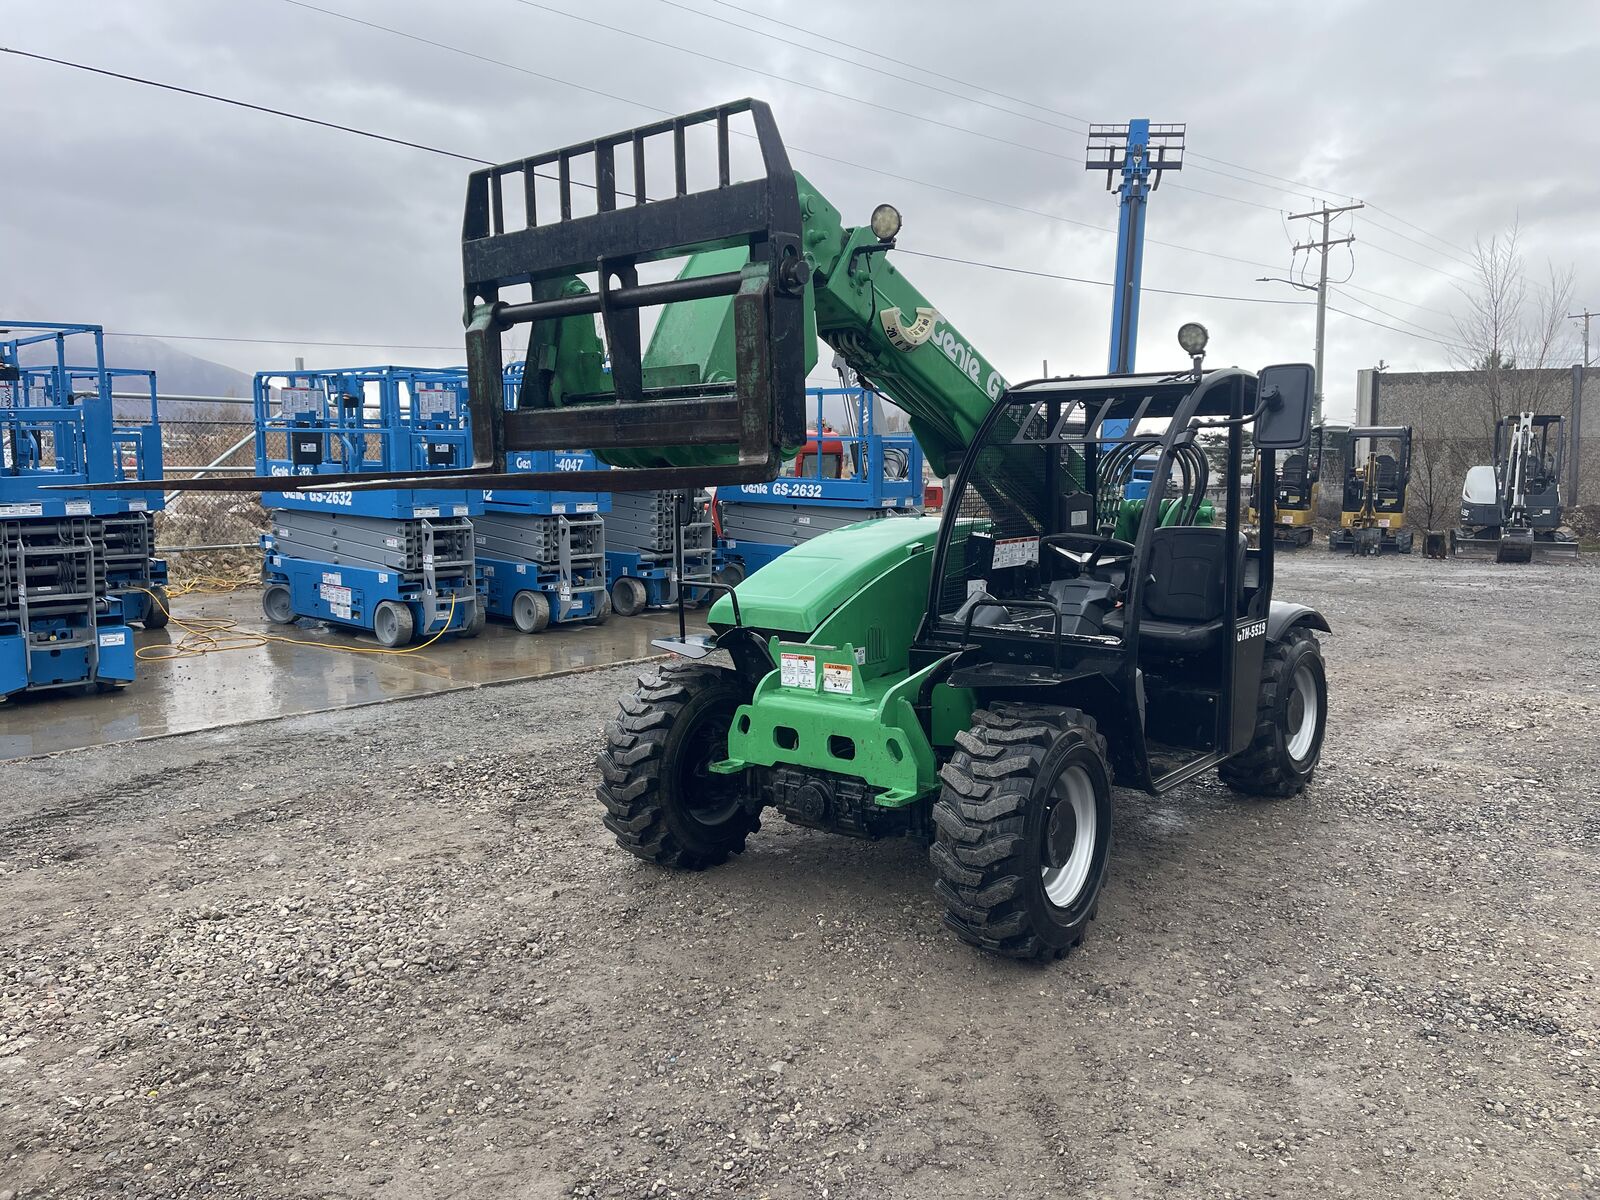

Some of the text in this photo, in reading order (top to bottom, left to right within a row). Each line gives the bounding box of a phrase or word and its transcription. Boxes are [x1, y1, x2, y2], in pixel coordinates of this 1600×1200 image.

[886, 326, 898, 339] -20
[932, 318, 981, 384] Genie
[554, 458, 584, 471] -4047
[309, 490, 352, 506] GS-2632
[742, 482, 822, 498] Genie GS-2632
[1236, 621, 1266, 642] GTH-5519
